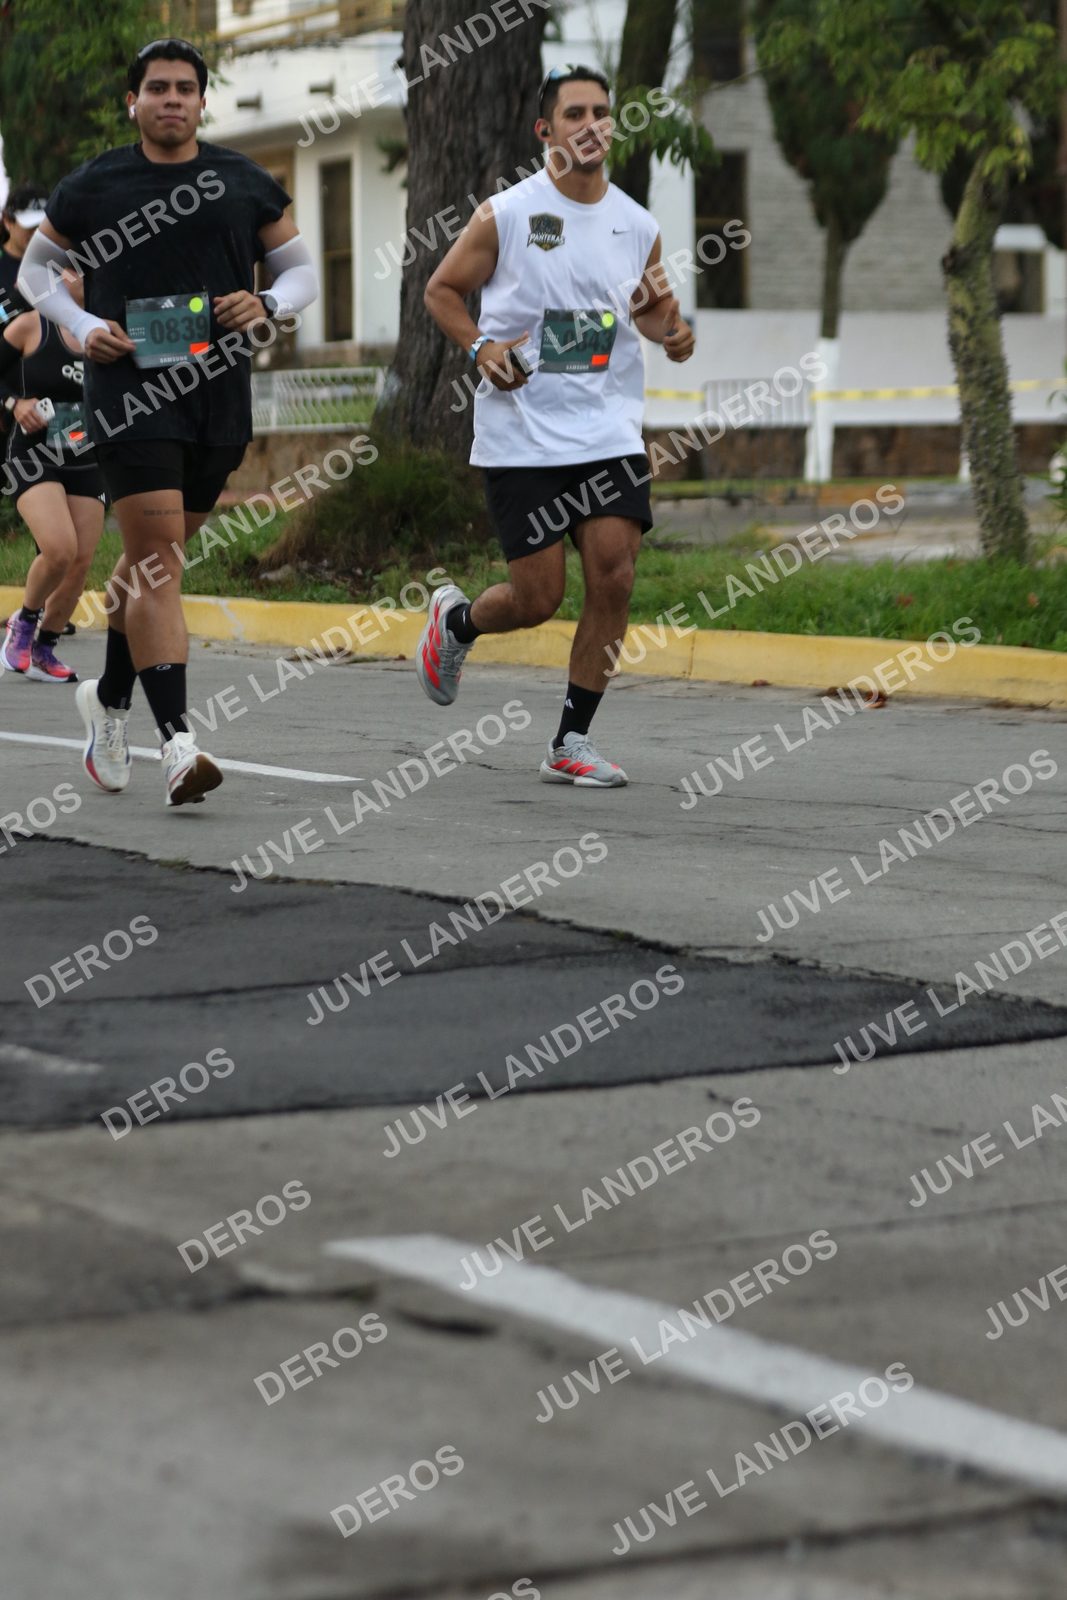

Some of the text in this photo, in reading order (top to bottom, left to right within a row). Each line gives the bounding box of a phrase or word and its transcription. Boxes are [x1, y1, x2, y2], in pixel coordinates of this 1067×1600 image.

[529, 232, 565, 245] PANTERAS
[150, 315, 209, 344] 0839
[160, 355, 187, 363] SAMSUNG
